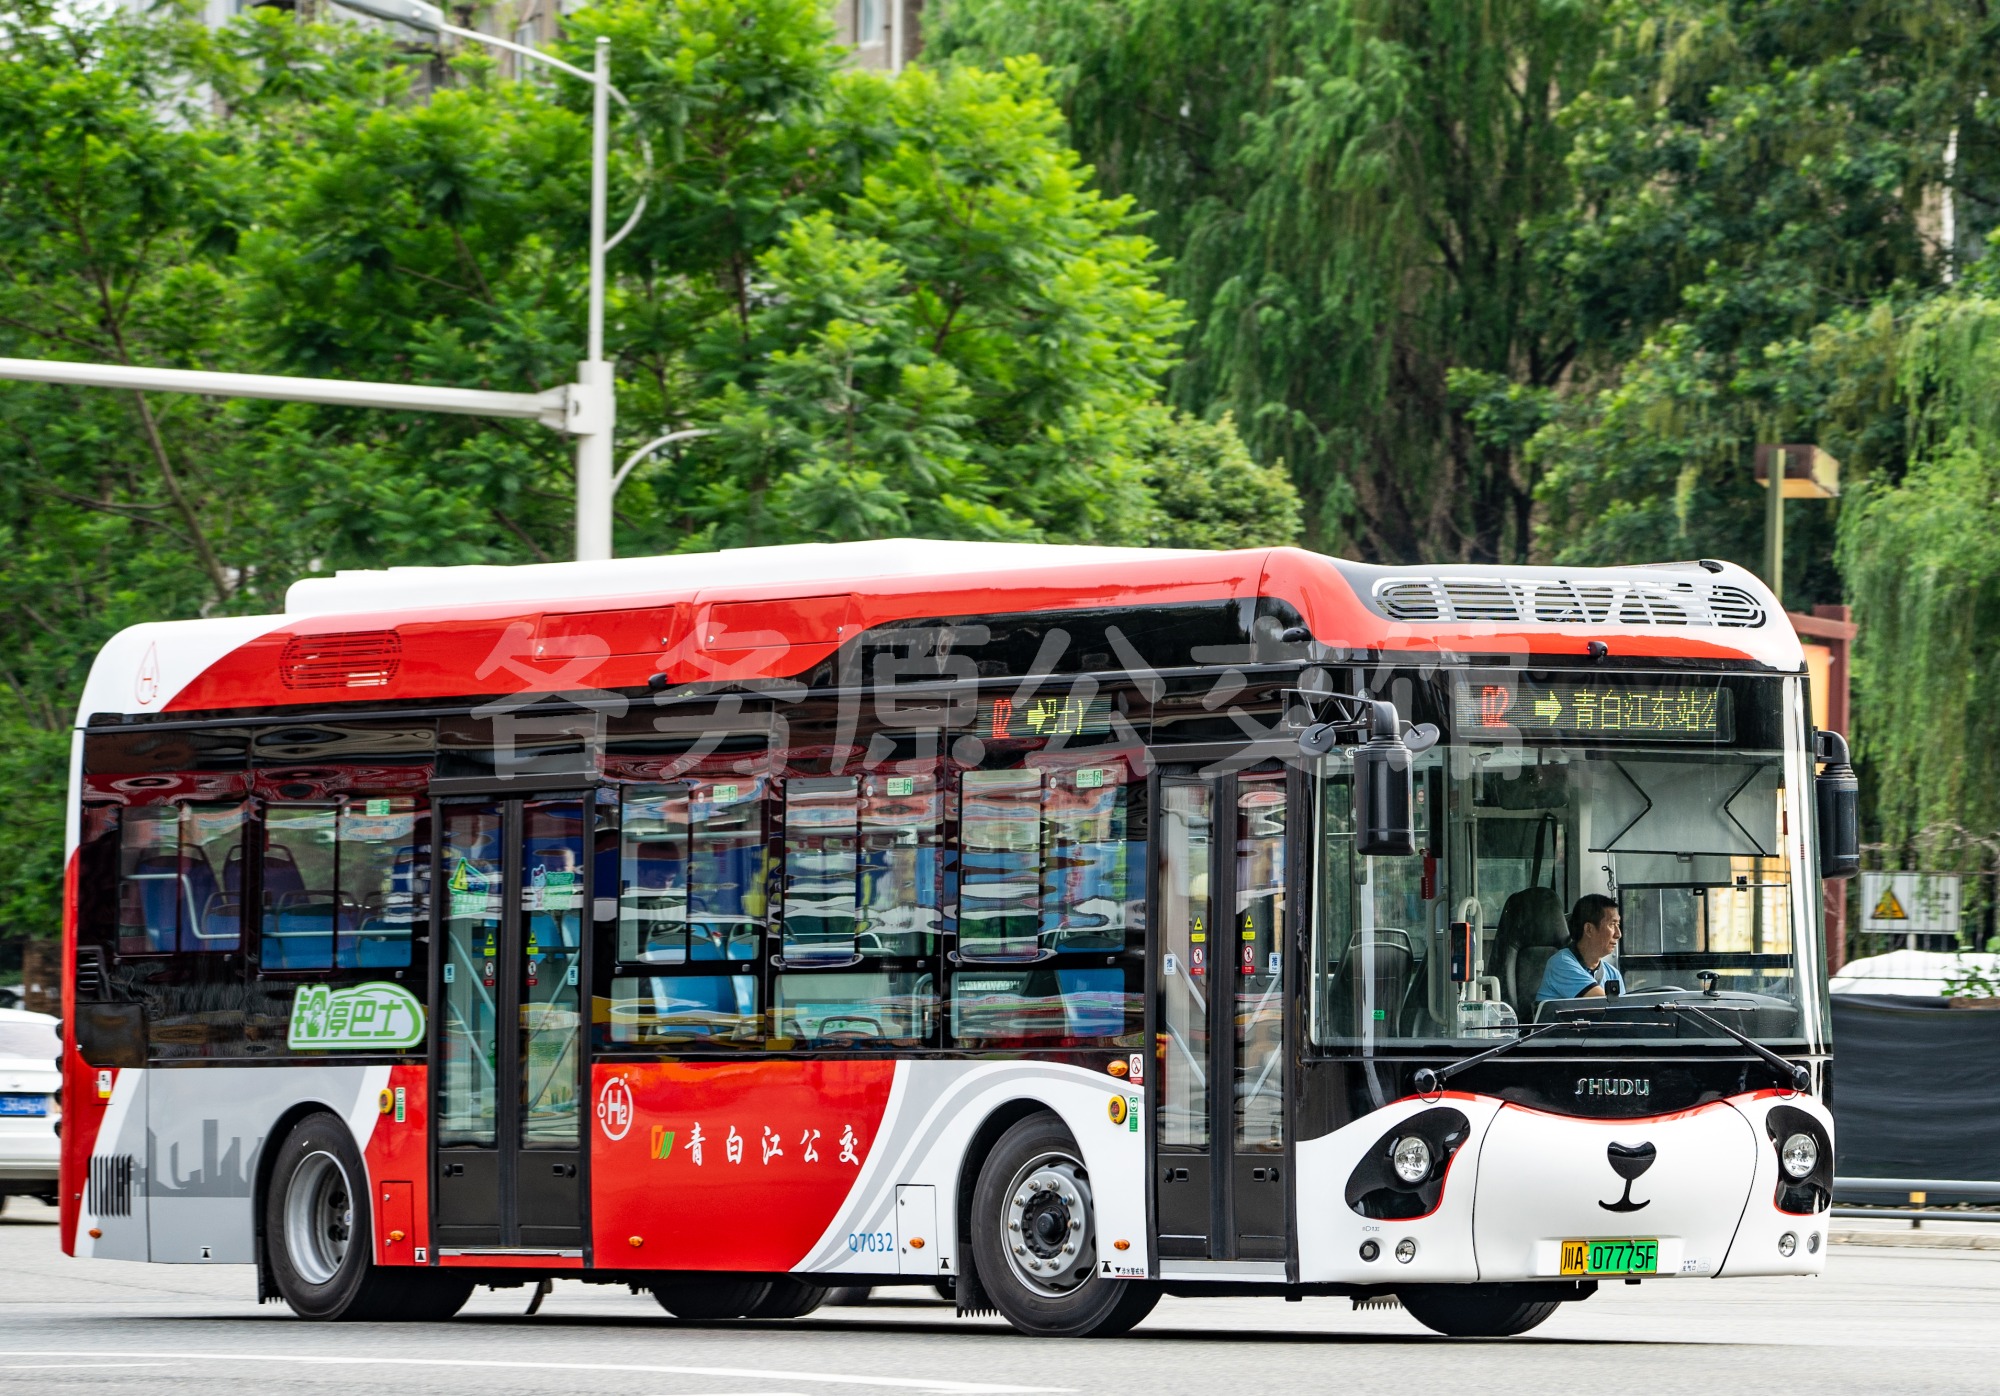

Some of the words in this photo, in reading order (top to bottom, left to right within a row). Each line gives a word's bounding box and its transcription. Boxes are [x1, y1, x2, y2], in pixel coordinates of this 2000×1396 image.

[1574, 1077, 1650, 1096] SHUDU
[683, 1121, 860, 1167] 青白江公交
[848, 1232, 894, 1253] Q7032
